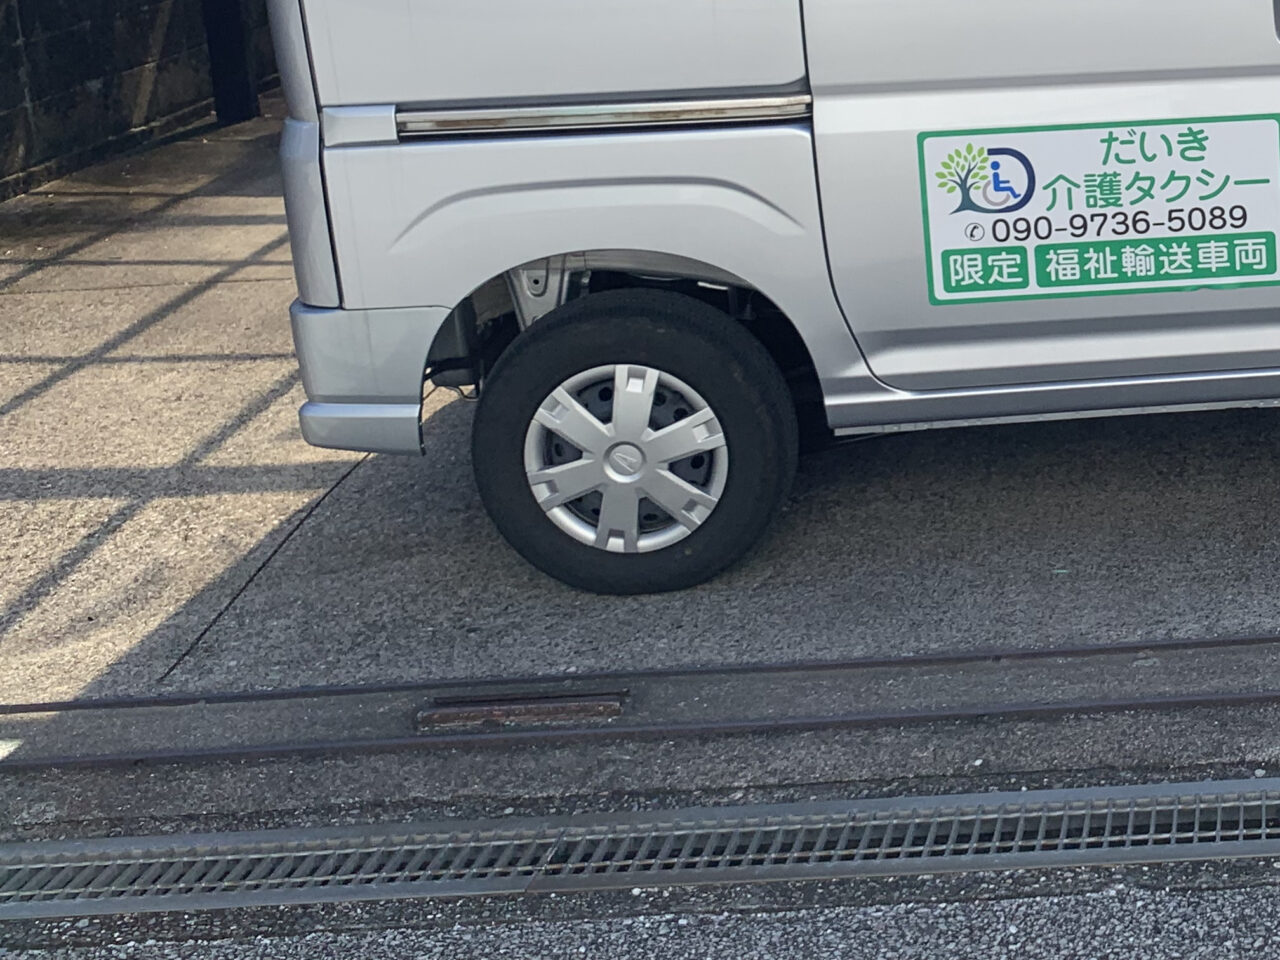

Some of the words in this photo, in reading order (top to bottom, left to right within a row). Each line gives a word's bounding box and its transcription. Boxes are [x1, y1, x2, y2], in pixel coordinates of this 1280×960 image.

[1100, 127, 1209, 166] だいき
[1042, 169, 1270, 211] 介護タクシー
[991, 204, 1248, 242] 090-9736-5089
[949, 250, 1023, 287] 限定
[1045, 238, 1268, 282] 福祉輸送車両
